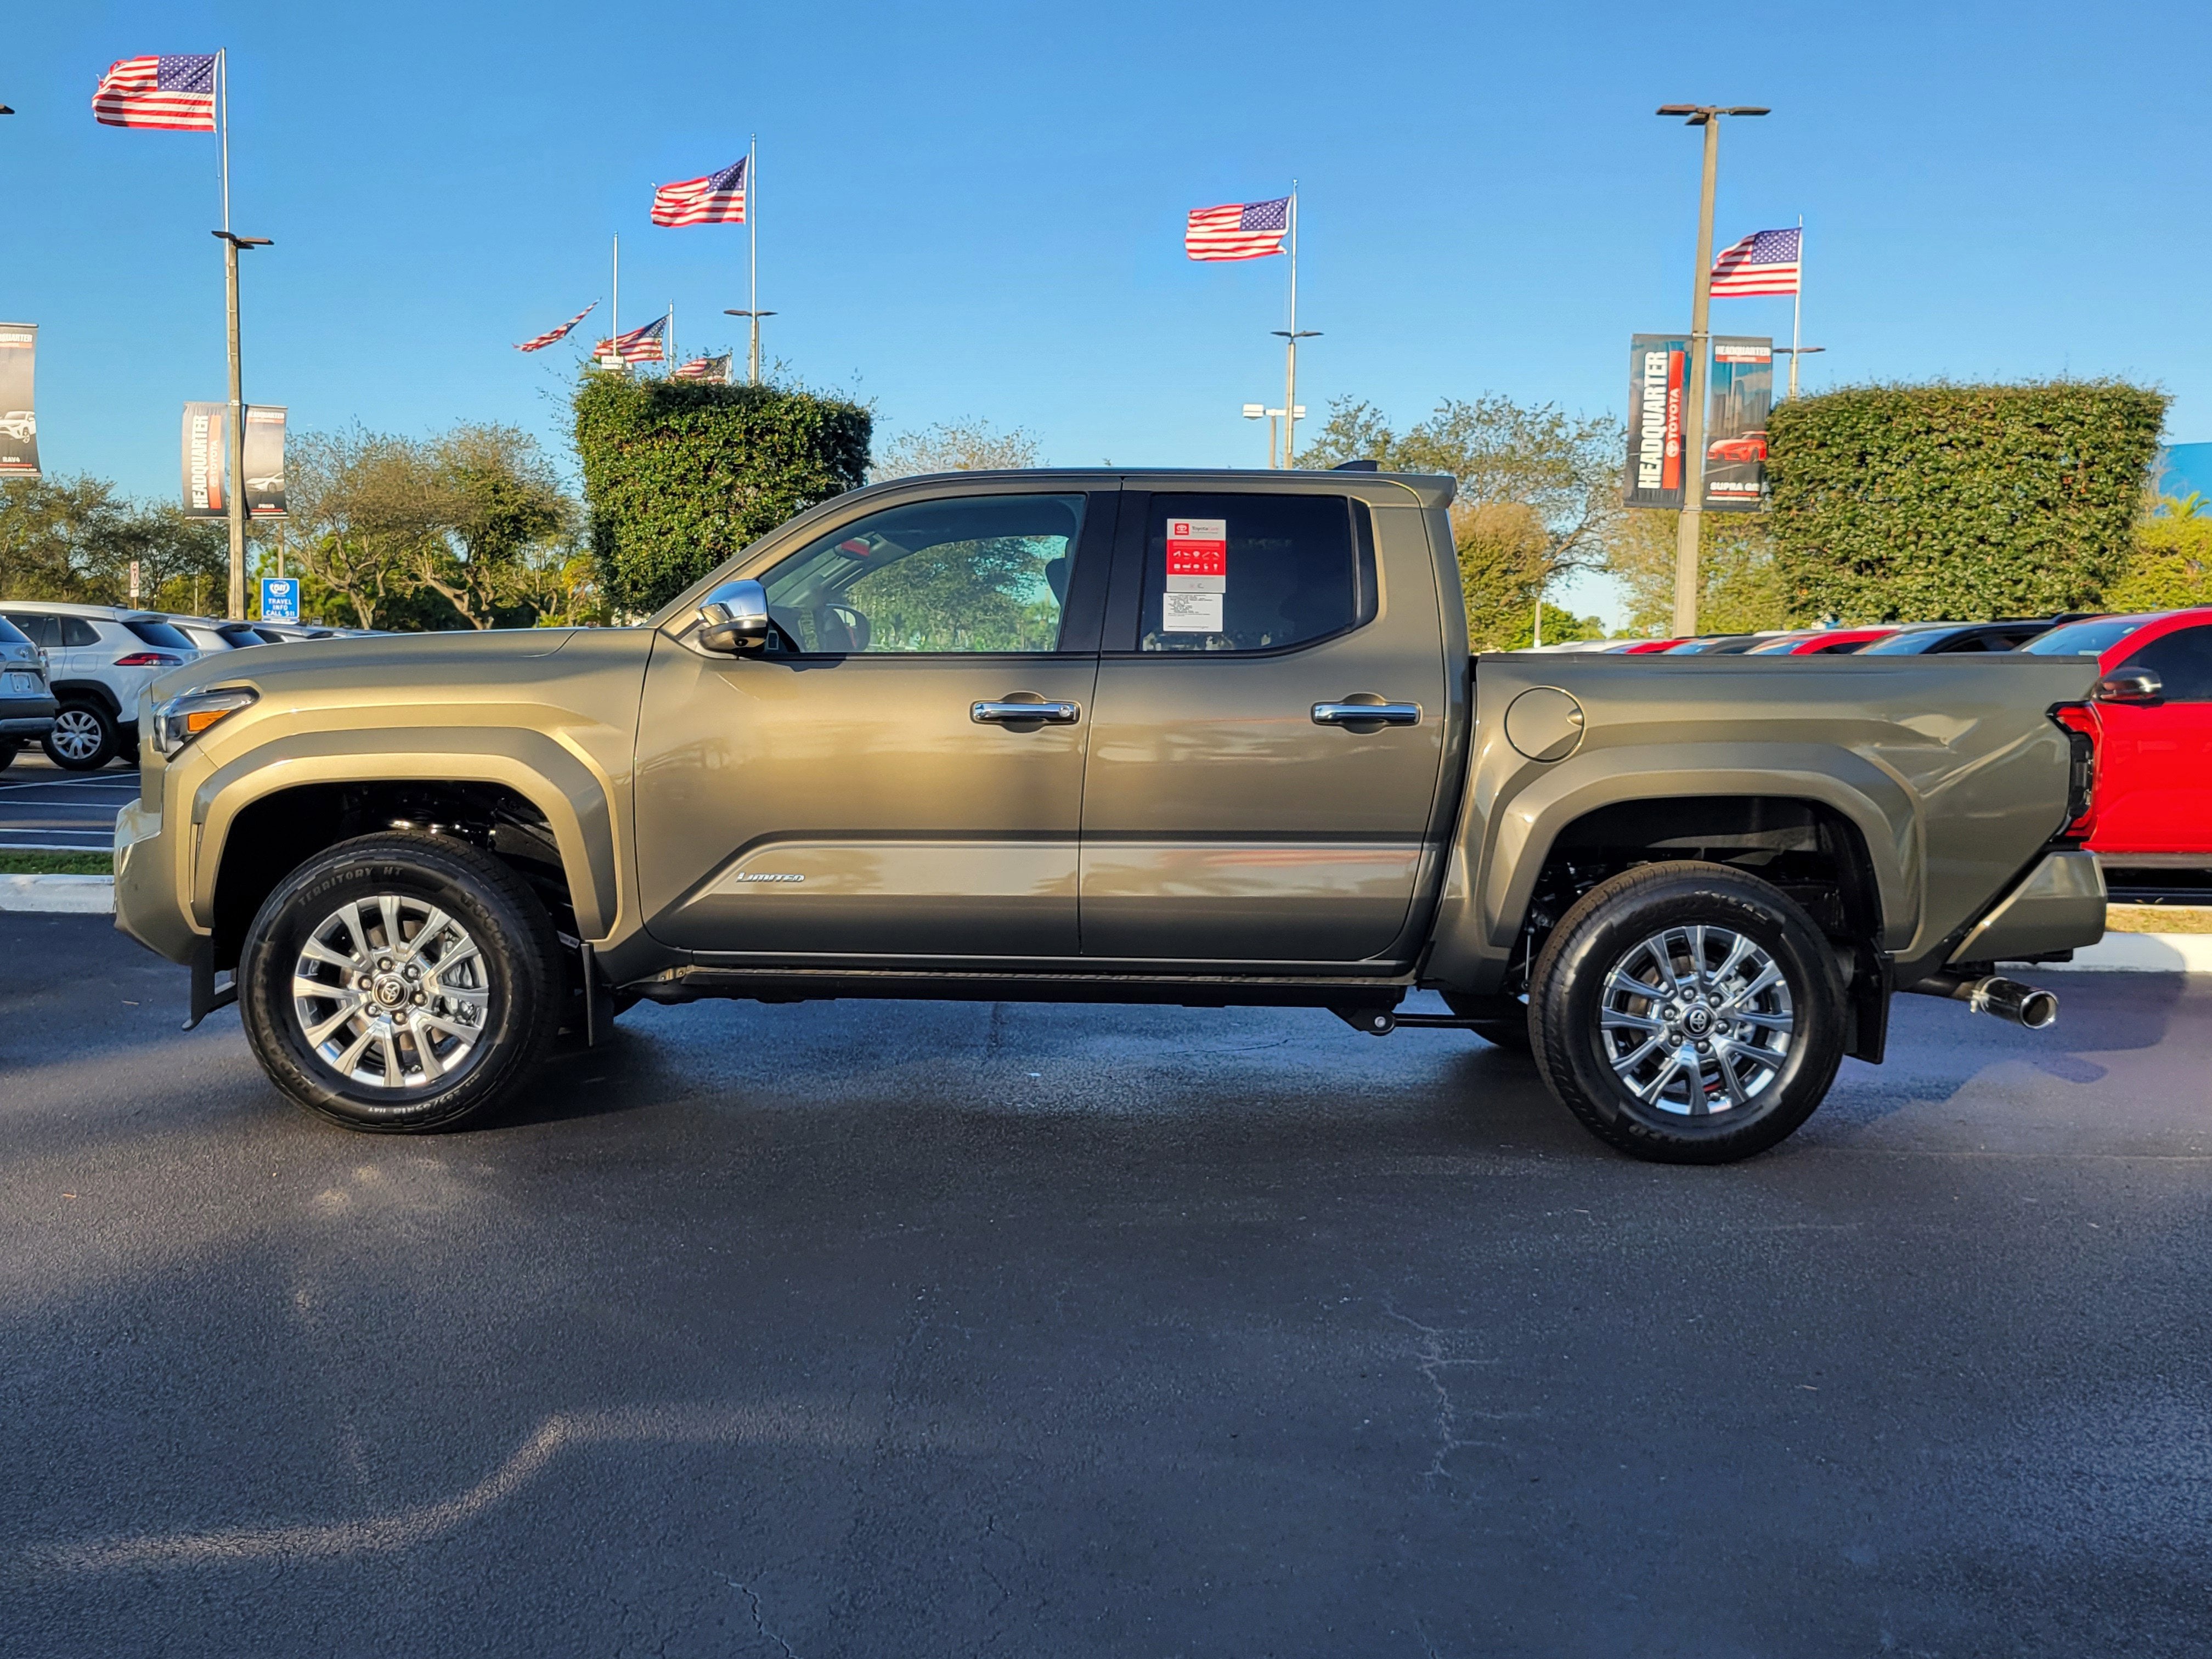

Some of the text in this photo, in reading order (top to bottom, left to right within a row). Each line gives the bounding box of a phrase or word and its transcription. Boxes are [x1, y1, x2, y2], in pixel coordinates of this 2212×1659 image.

[1714, 345, 1771, 356] HEADQUARTER
[1638, 351, 1668, 489] HEADQUARTER
[1667, 387, 1680, 439] TOYOTA
[191, 415, 210, 509] HEADQUARTER
[210, 439, 219, 469] TOYOTA
[1710, 482, 1743, 491] SUPRA
[298, 866, 404, 906] TERRITORY HT
[736, 871, 805, 883] LIMITED
